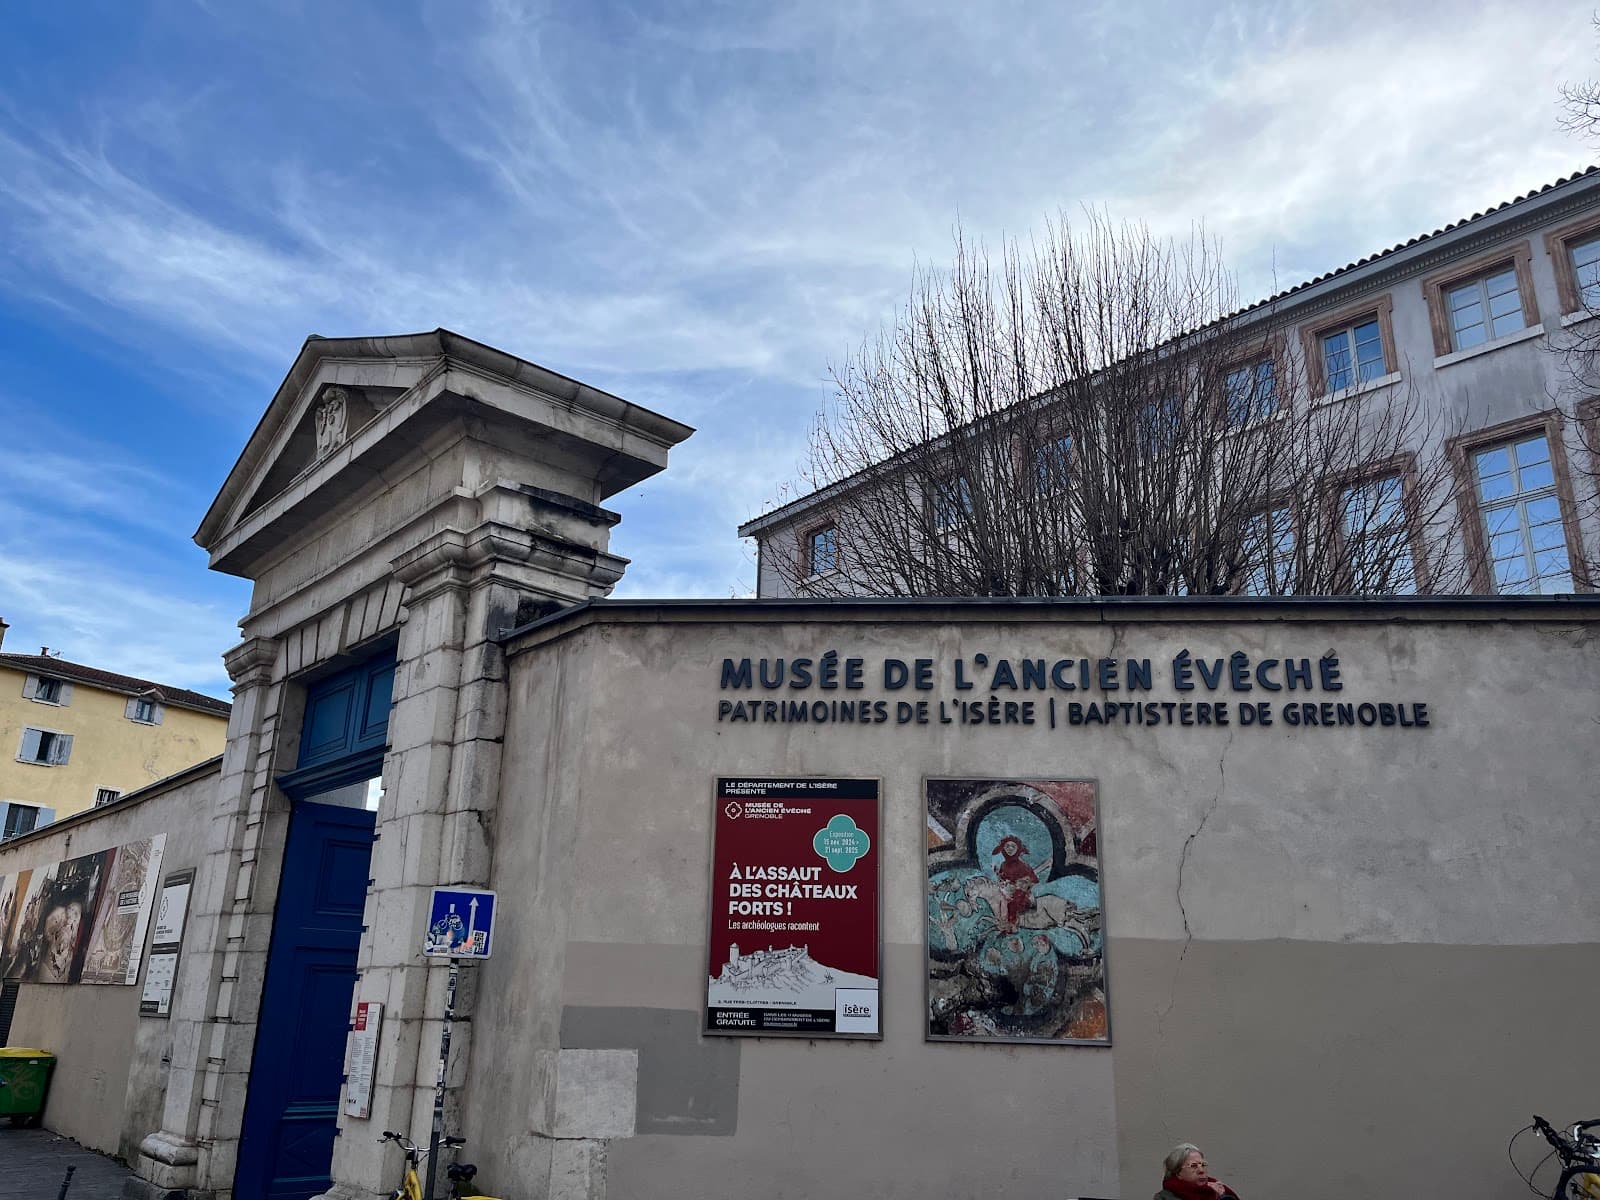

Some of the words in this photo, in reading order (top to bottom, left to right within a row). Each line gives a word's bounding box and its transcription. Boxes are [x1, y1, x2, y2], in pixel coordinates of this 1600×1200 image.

[720, 650, 864, 690] MUSÉE
[884, 658, 934, 690] DE
[955, 653, 1152, 690] L'ANCIEN
[1172, 648, 1343, 690] ÉVÊCHÉ
[718, 700, 888, 724] PATRIMOINES
[897, 701, 929, 724] DE
[940, 696, 1036, 725] L'ISÈRE
[1068, 702, 1229, 727] BAPTISTERE
[1239, 703, 1273, 726] DE
[1283, 703, 1430, 727] GRENOBLE
[729, 862, 742, 880] À
[745, 866, 822, 880] L'ASSAUT
[729, 884, 762, 898] DES
[765, 881, 858, 899] CHÂTEAUX
[728, 901, 784, 916] FORTS
[728, 920, 740, 930] Les
[742, 920, 786, 932] archéologues
[788, 922, 820, 931] racontent
[844, 1004, 870, 1014] isère
